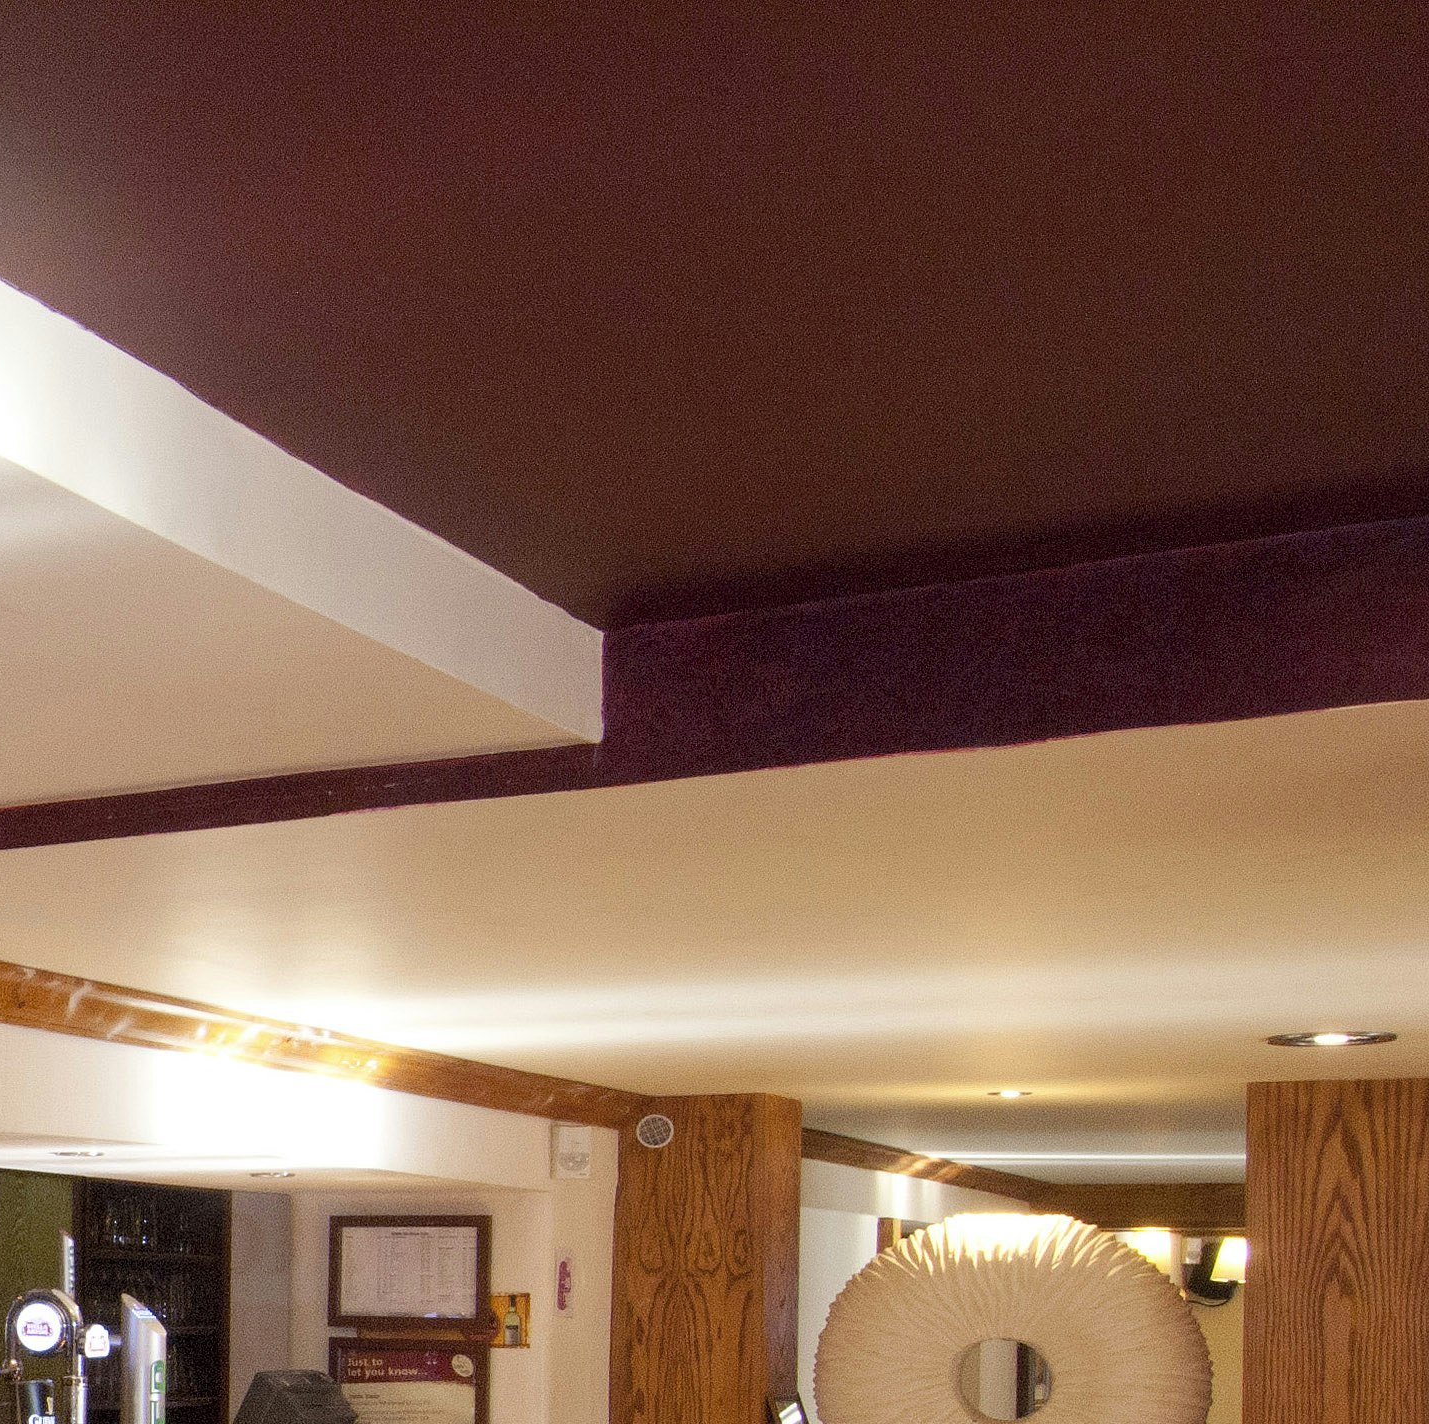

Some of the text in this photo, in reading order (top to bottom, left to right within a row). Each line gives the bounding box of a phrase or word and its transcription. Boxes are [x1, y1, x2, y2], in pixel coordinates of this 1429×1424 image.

[347, 1358, 383, 1367] Just to
[365, 1369, 385, 1381] you
